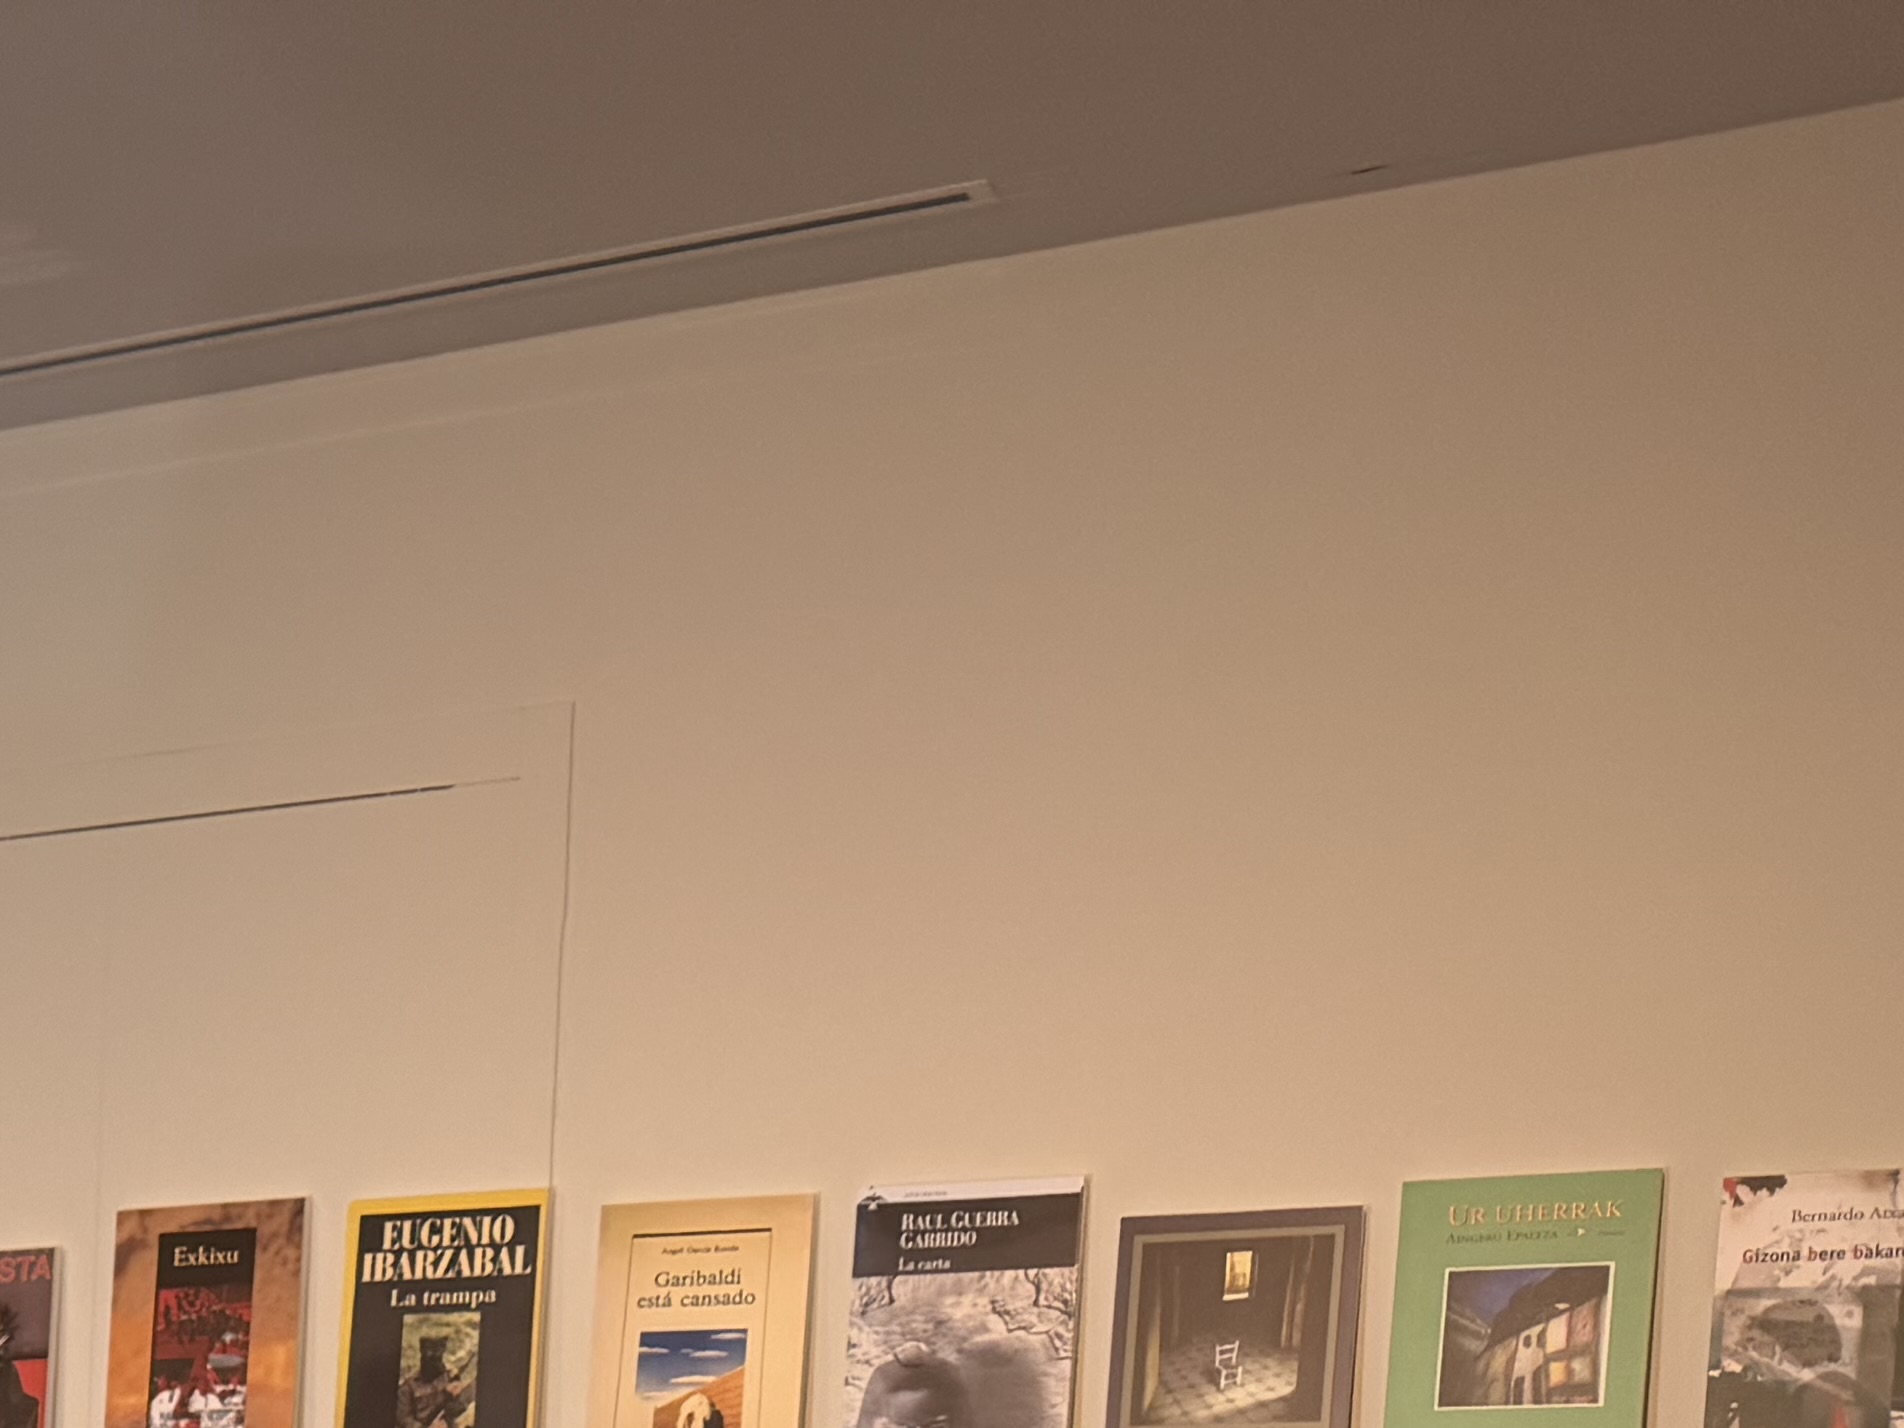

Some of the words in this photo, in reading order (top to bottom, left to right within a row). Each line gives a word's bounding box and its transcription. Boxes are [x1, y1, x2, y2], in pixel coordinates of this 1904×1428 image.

[1448, 1204, 1486, 1227] UR
[1495, 1200, 1623, 1225] UHERRAK
[382, 1215, 515, 1251] EUGENIO
[899, 1231, 976, 1249] GARRIDO
[173, 1246, 239, 1268] Exkixu
[361, 1246, 532, 1282] IBARZABAL
[898, 1256, 915, 1271] La
[918, 1256, 951, 1271] carta
[655, 1268, 741, 1289] Garibaldi
[390, 1289, 416, 1307] La
[422, 1288, 497, 1309] trampa
[638, 1290, 673, 1309] está
[680, 1289, 756, 1309] cansado
